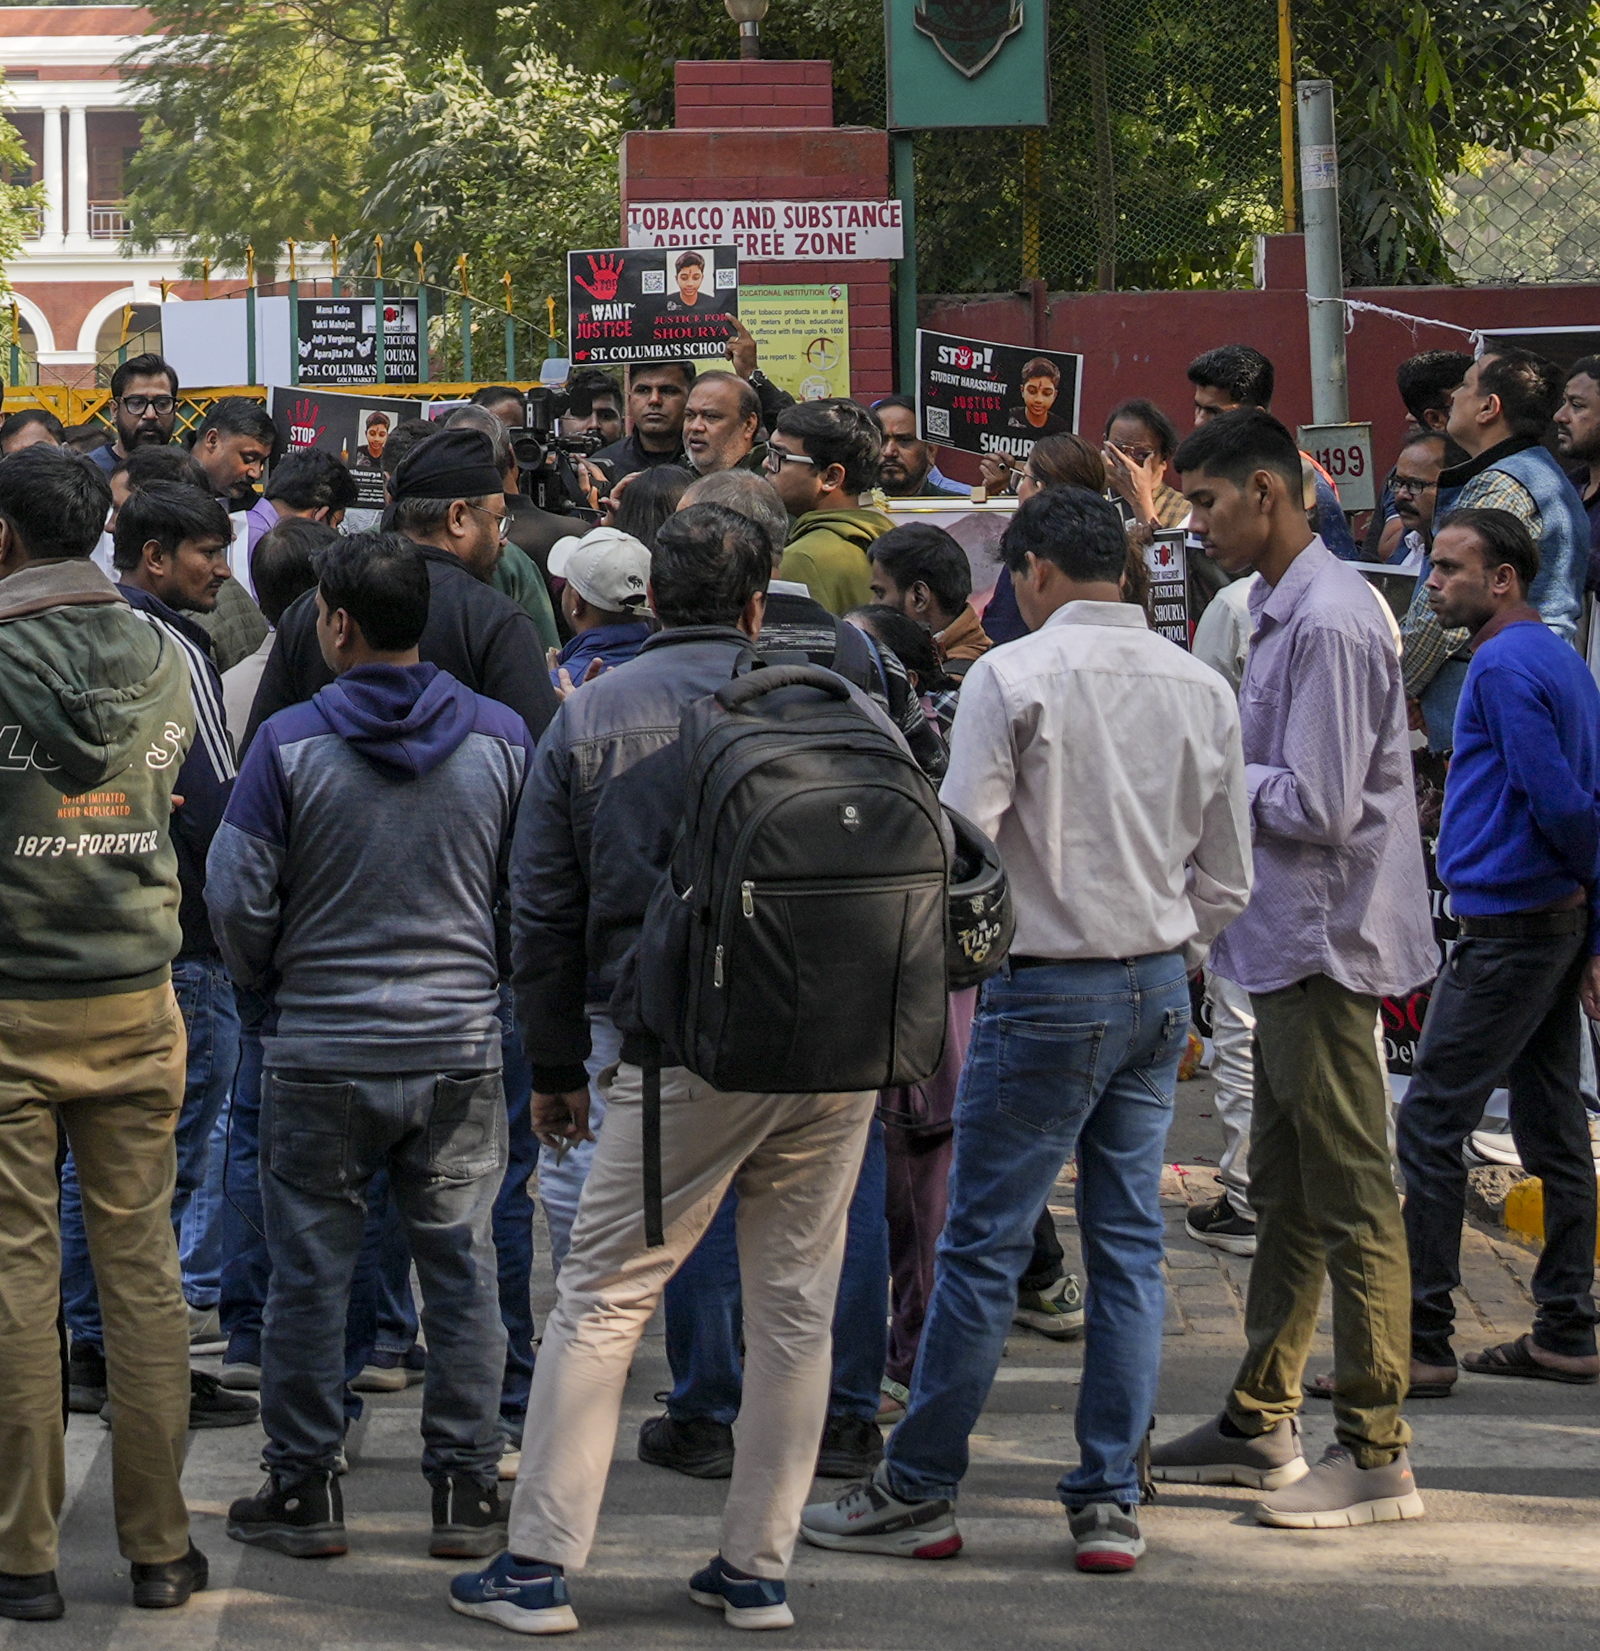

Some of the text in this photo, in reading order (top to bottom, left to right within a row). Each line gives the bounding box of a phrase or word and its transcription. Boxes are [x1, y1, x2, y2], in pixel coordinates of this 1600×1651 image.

[627, 202, 901, 231] TOBACCO AND SUBSTANCE
[734, 233, 783, 256] FREE
[794, 232, 857, 256] ZONE
[783, 289, 824, 297] INSTITUTION
[591, 302, 636, 321] WANT
[654, 314, 700, 325] JUSTICE
[784, 308, 810, 316] products
[576, 321, 632, 339] JUSTICE
[653, 325, 729, 340] SHOURYA
[591, 343, 682, 360] ST. COLUMBA'S
[307, 364, 377, 376] ST. COLUMBA'S
[930, 370, 1008, 395] STUDENT HARASSMENT
[952, 396, 1002, 410] JUSTICE
[966, 411, 989, 425] FOR
[290, 425, 316, 443] STOP
[1154, 604, 1186, 622] SHOURYA
[88, 792, 126, 804] IMITATED
[57, 805, 131, 819] NEVER REPLICATED
[14, 830, 158, 857] 1873-FOREVER
